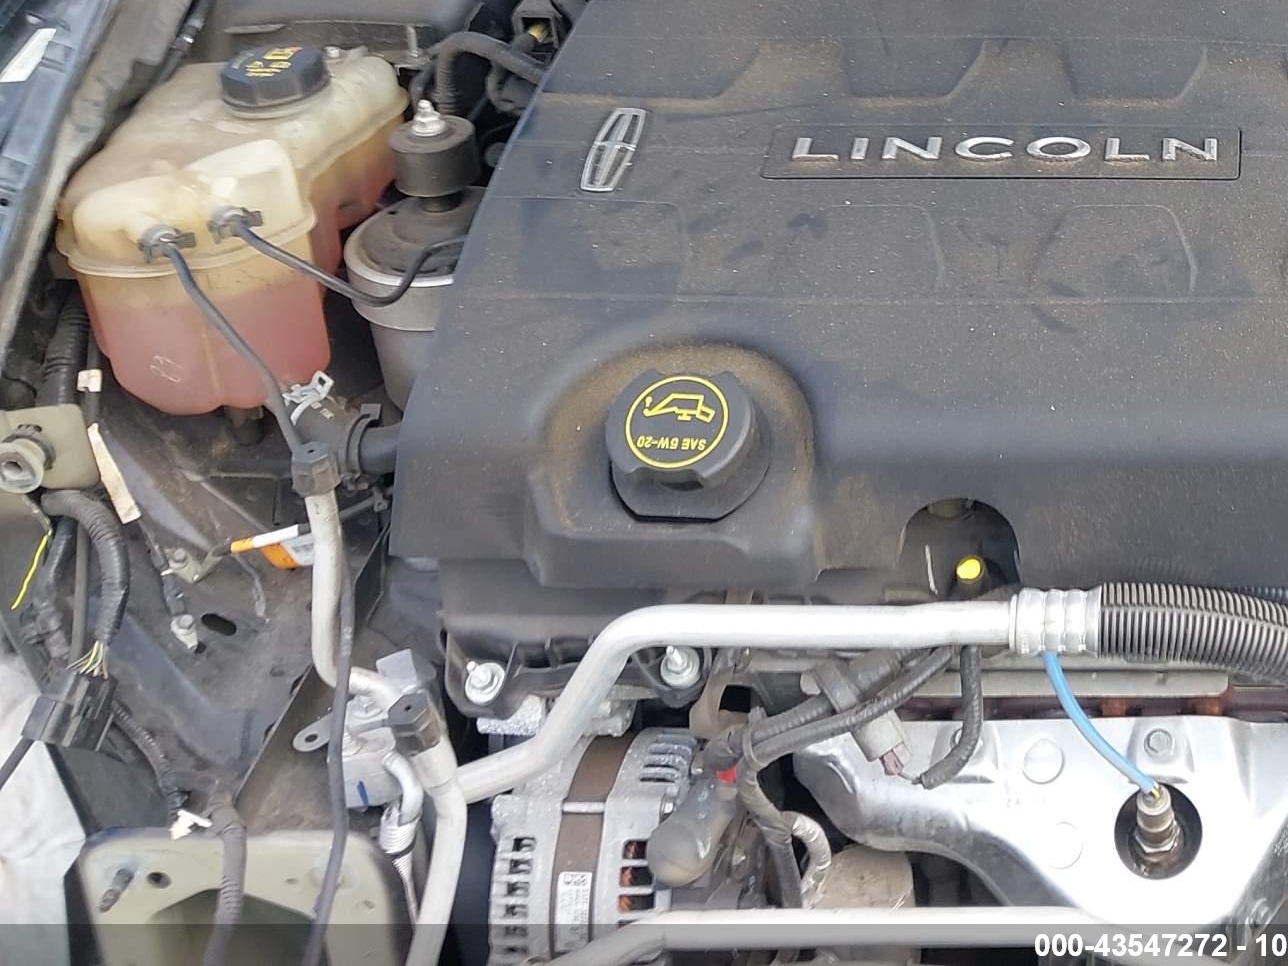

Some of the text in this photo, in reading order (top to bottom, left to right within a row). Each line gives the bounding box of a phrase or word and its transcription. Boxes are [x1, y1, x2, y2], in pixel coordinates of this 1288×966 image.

[791, 135, 1218, 163] LINCOLN
[636, 435, 707, 451] SAE 5W-20
